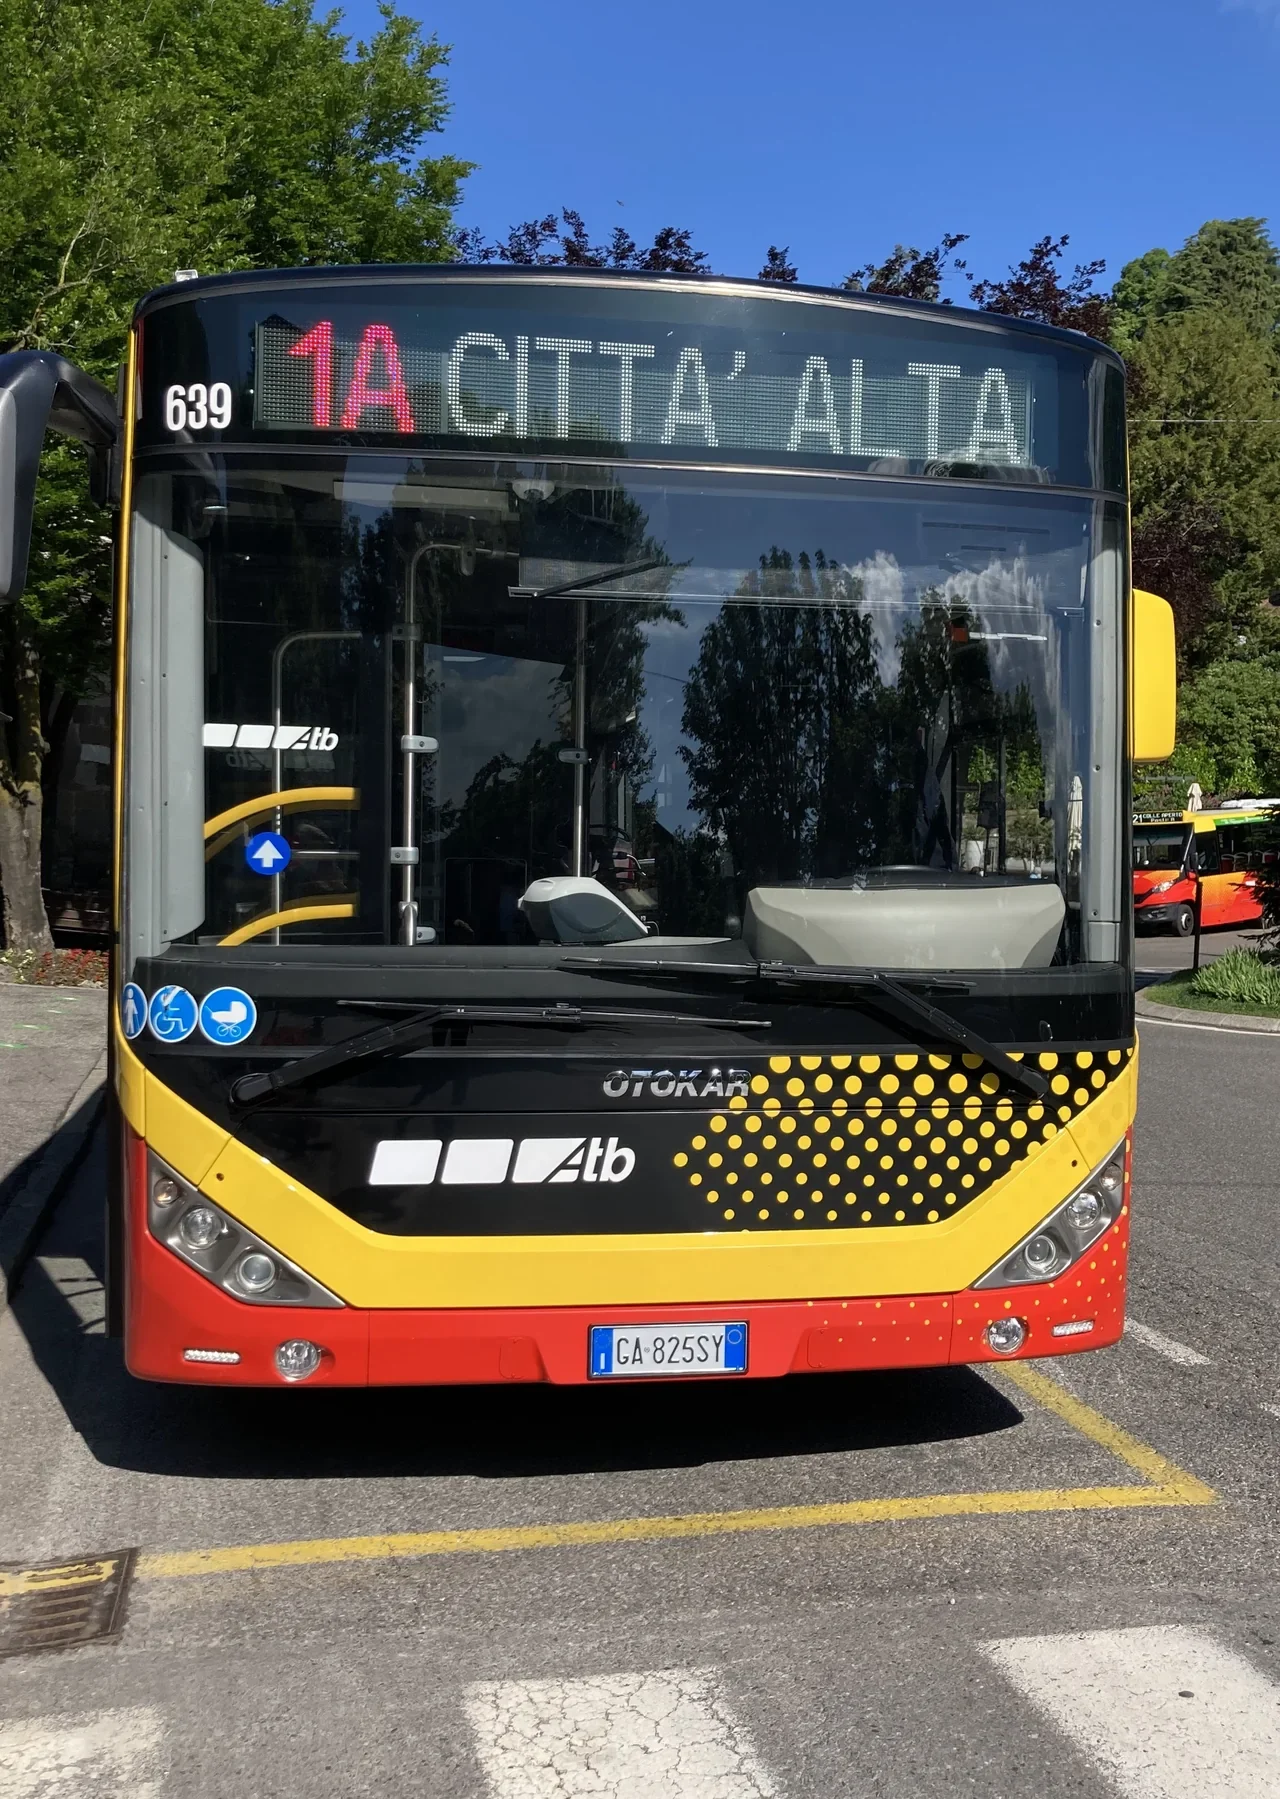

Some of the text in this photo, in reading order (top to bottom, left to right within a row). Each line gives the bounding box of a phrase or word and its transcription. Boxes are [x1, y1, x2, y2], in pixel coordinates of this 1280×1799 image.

[164, 382, 233, 431] 639
[289, 320, 1022, 465] 1A CITTA' ALTA
[602, 1068, 752, 1098] OTOKAR
